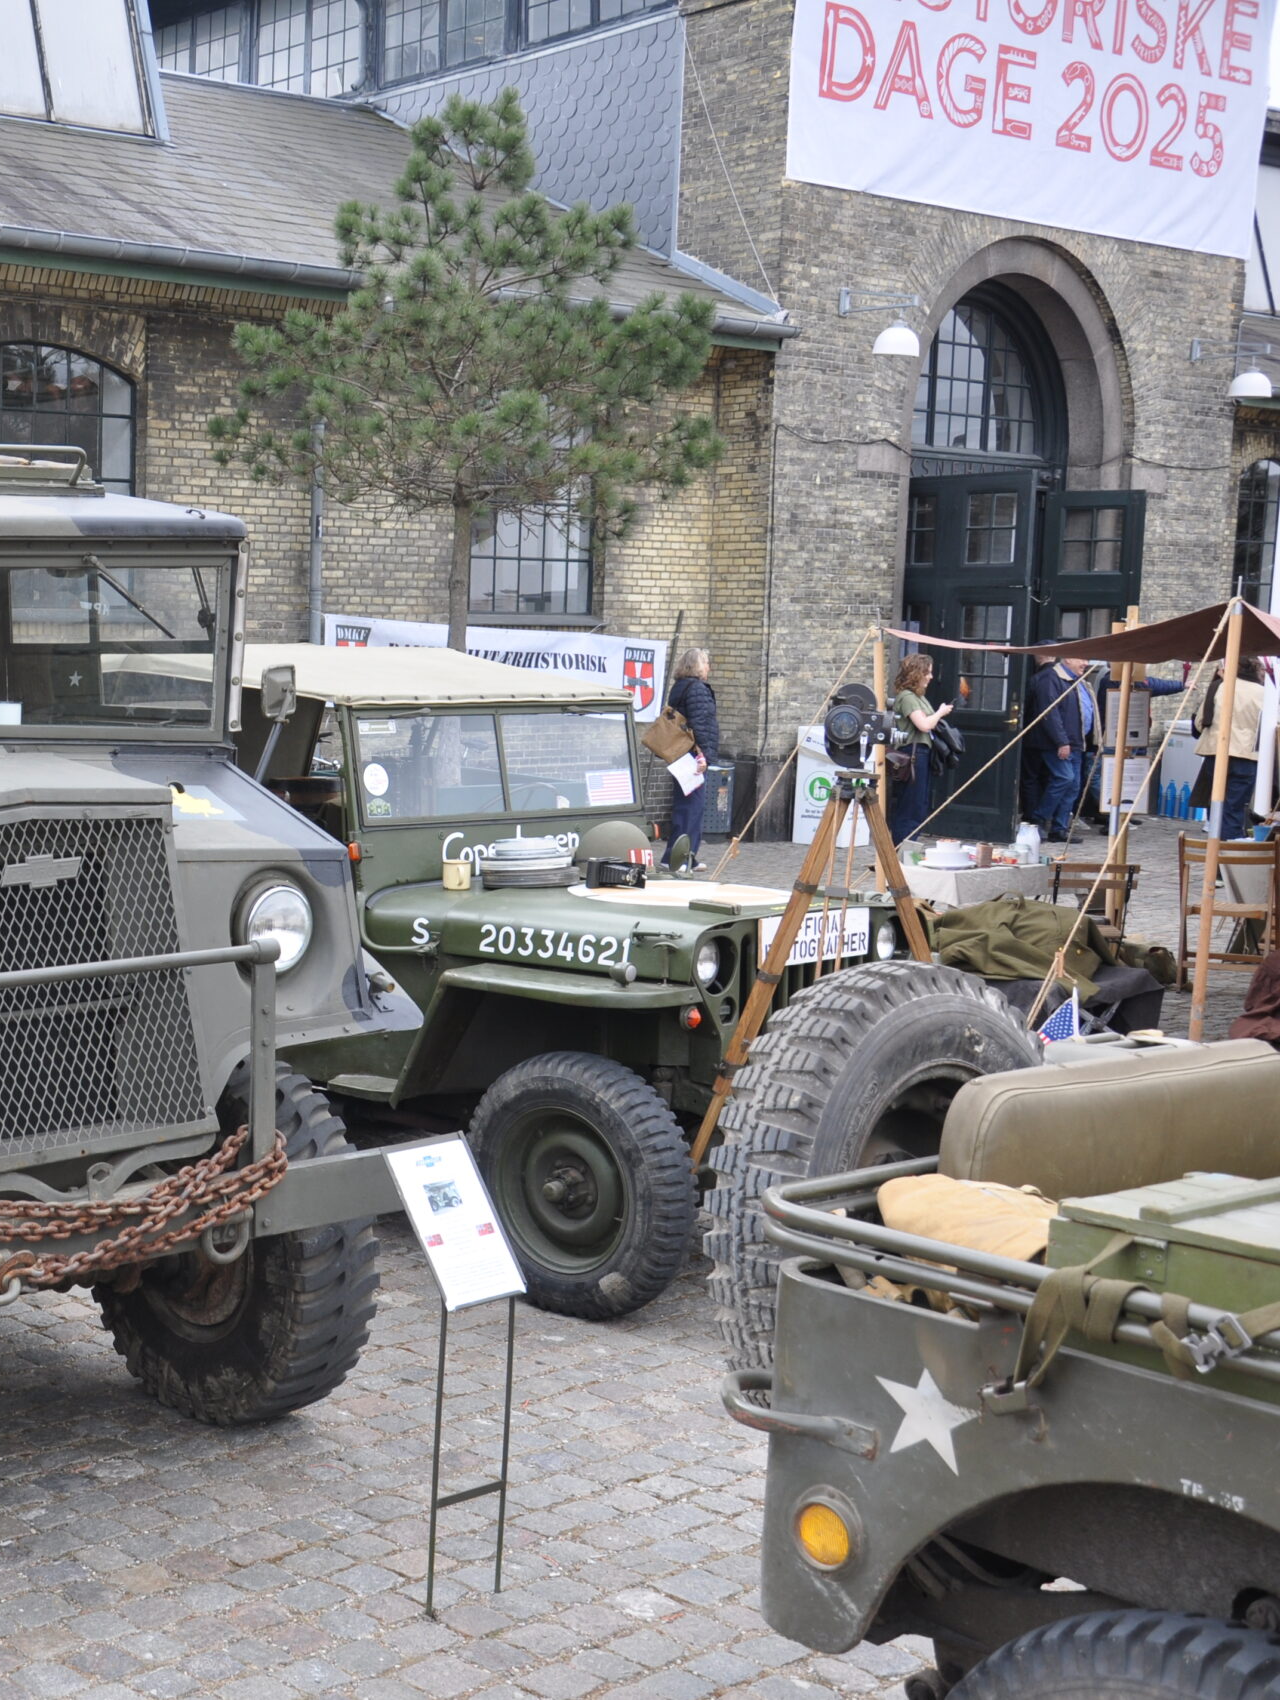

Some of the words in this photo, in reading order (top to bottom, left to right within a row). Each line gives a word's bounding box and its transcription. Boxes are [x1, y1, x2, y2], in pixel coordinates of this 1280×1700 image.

[818, 2, 1037, 141] DAGE
[1055, 61, 1227, 178] 2025
[625, 649, 654, 663] DMKF
[442, 824, 580, 876] Copeen
[411, 917, 430, 945] S
[479, 923, 631, 966] 20334621
